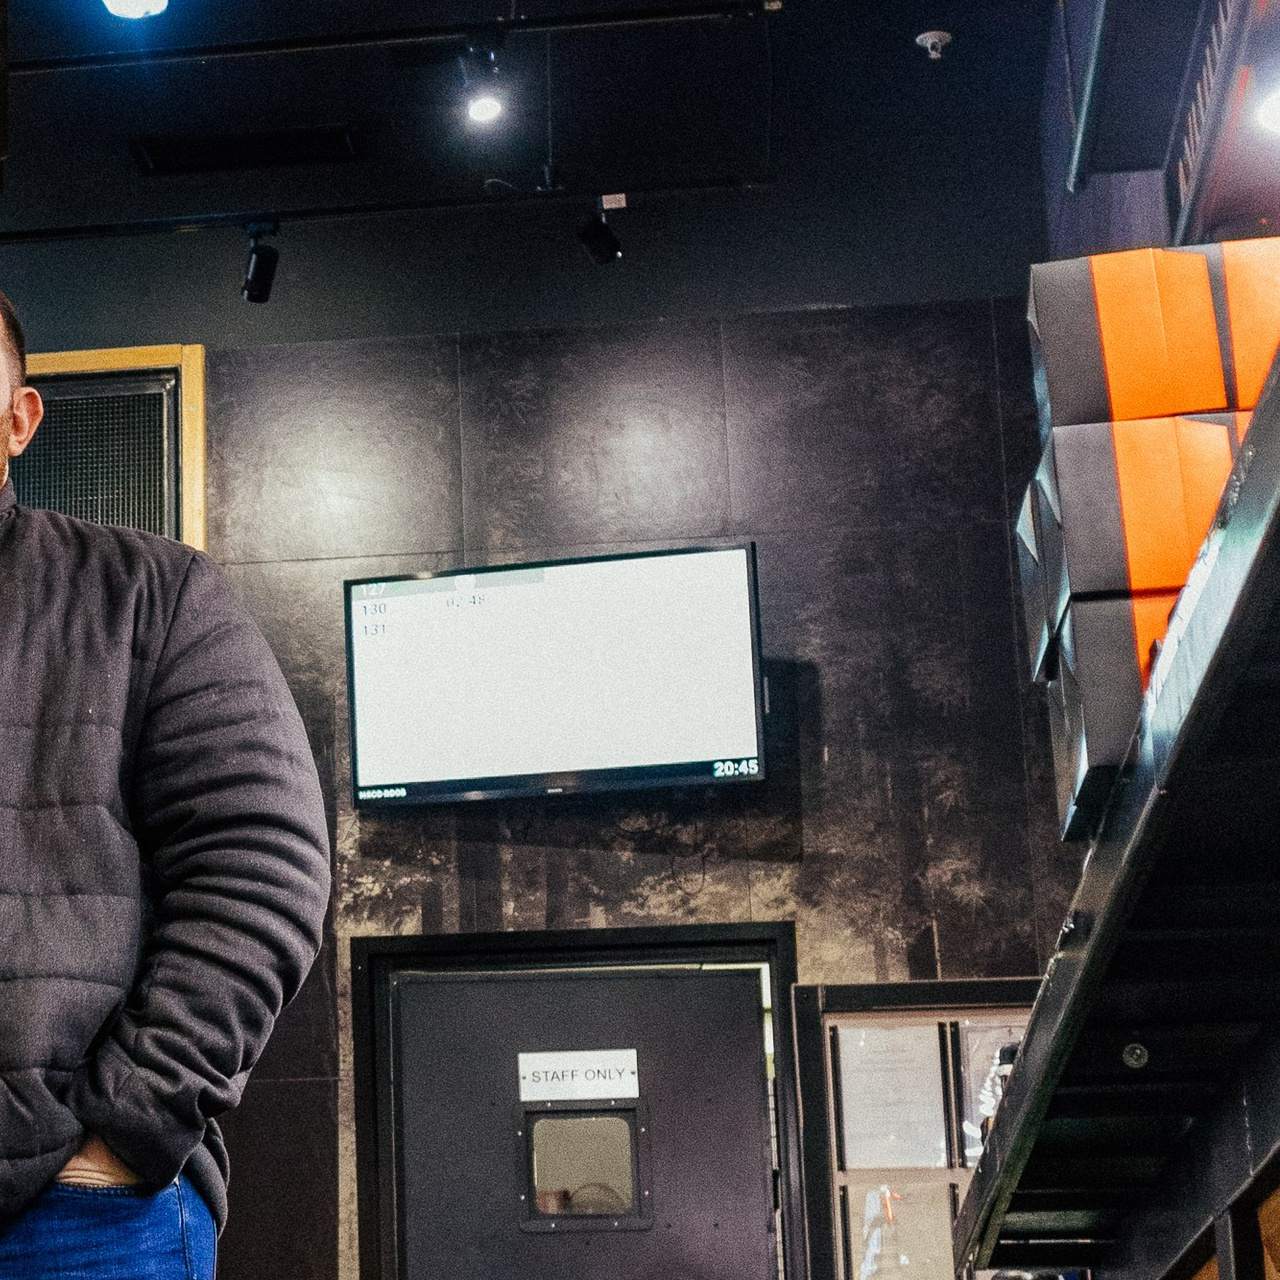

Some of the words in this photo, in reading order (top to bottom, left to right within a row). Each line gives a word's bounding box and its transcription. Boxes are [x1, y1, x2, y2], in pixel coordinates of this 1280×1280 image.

[363, 602, 388, 616] 130
[363, 623, 387, 636] 131
[712, 758, 759, 778] 20:45
[531, 1069, 579, 1083] STAFF
[584, 1067, 626, 1081] ONLY
